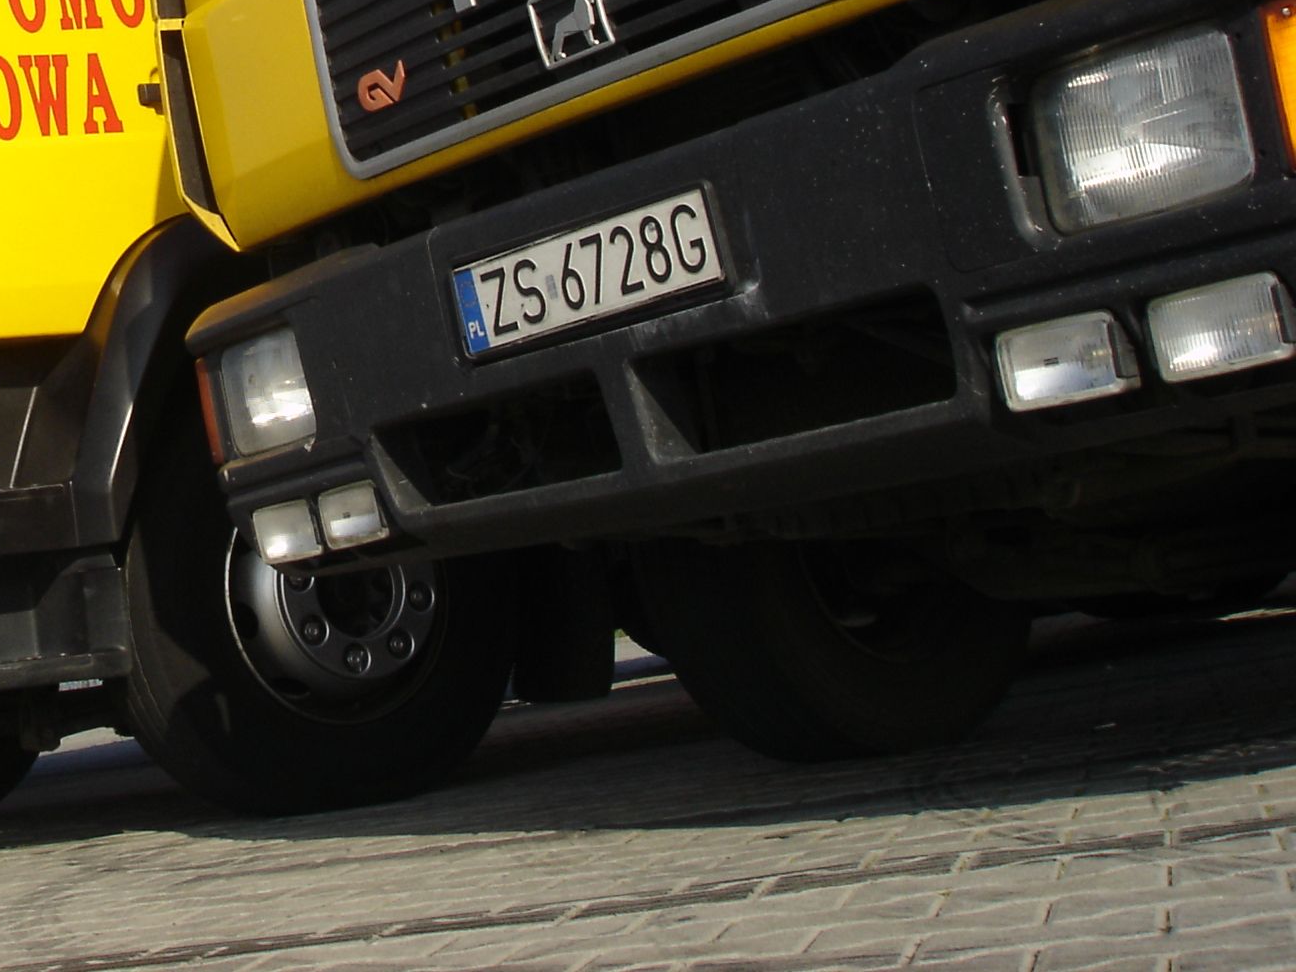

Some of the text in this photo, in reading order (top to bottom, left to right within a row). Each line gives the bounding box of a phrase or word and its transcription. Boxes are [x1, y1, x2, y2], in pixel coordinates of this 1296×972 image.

[468, 204, 707, 339] PL ZS 6728G
